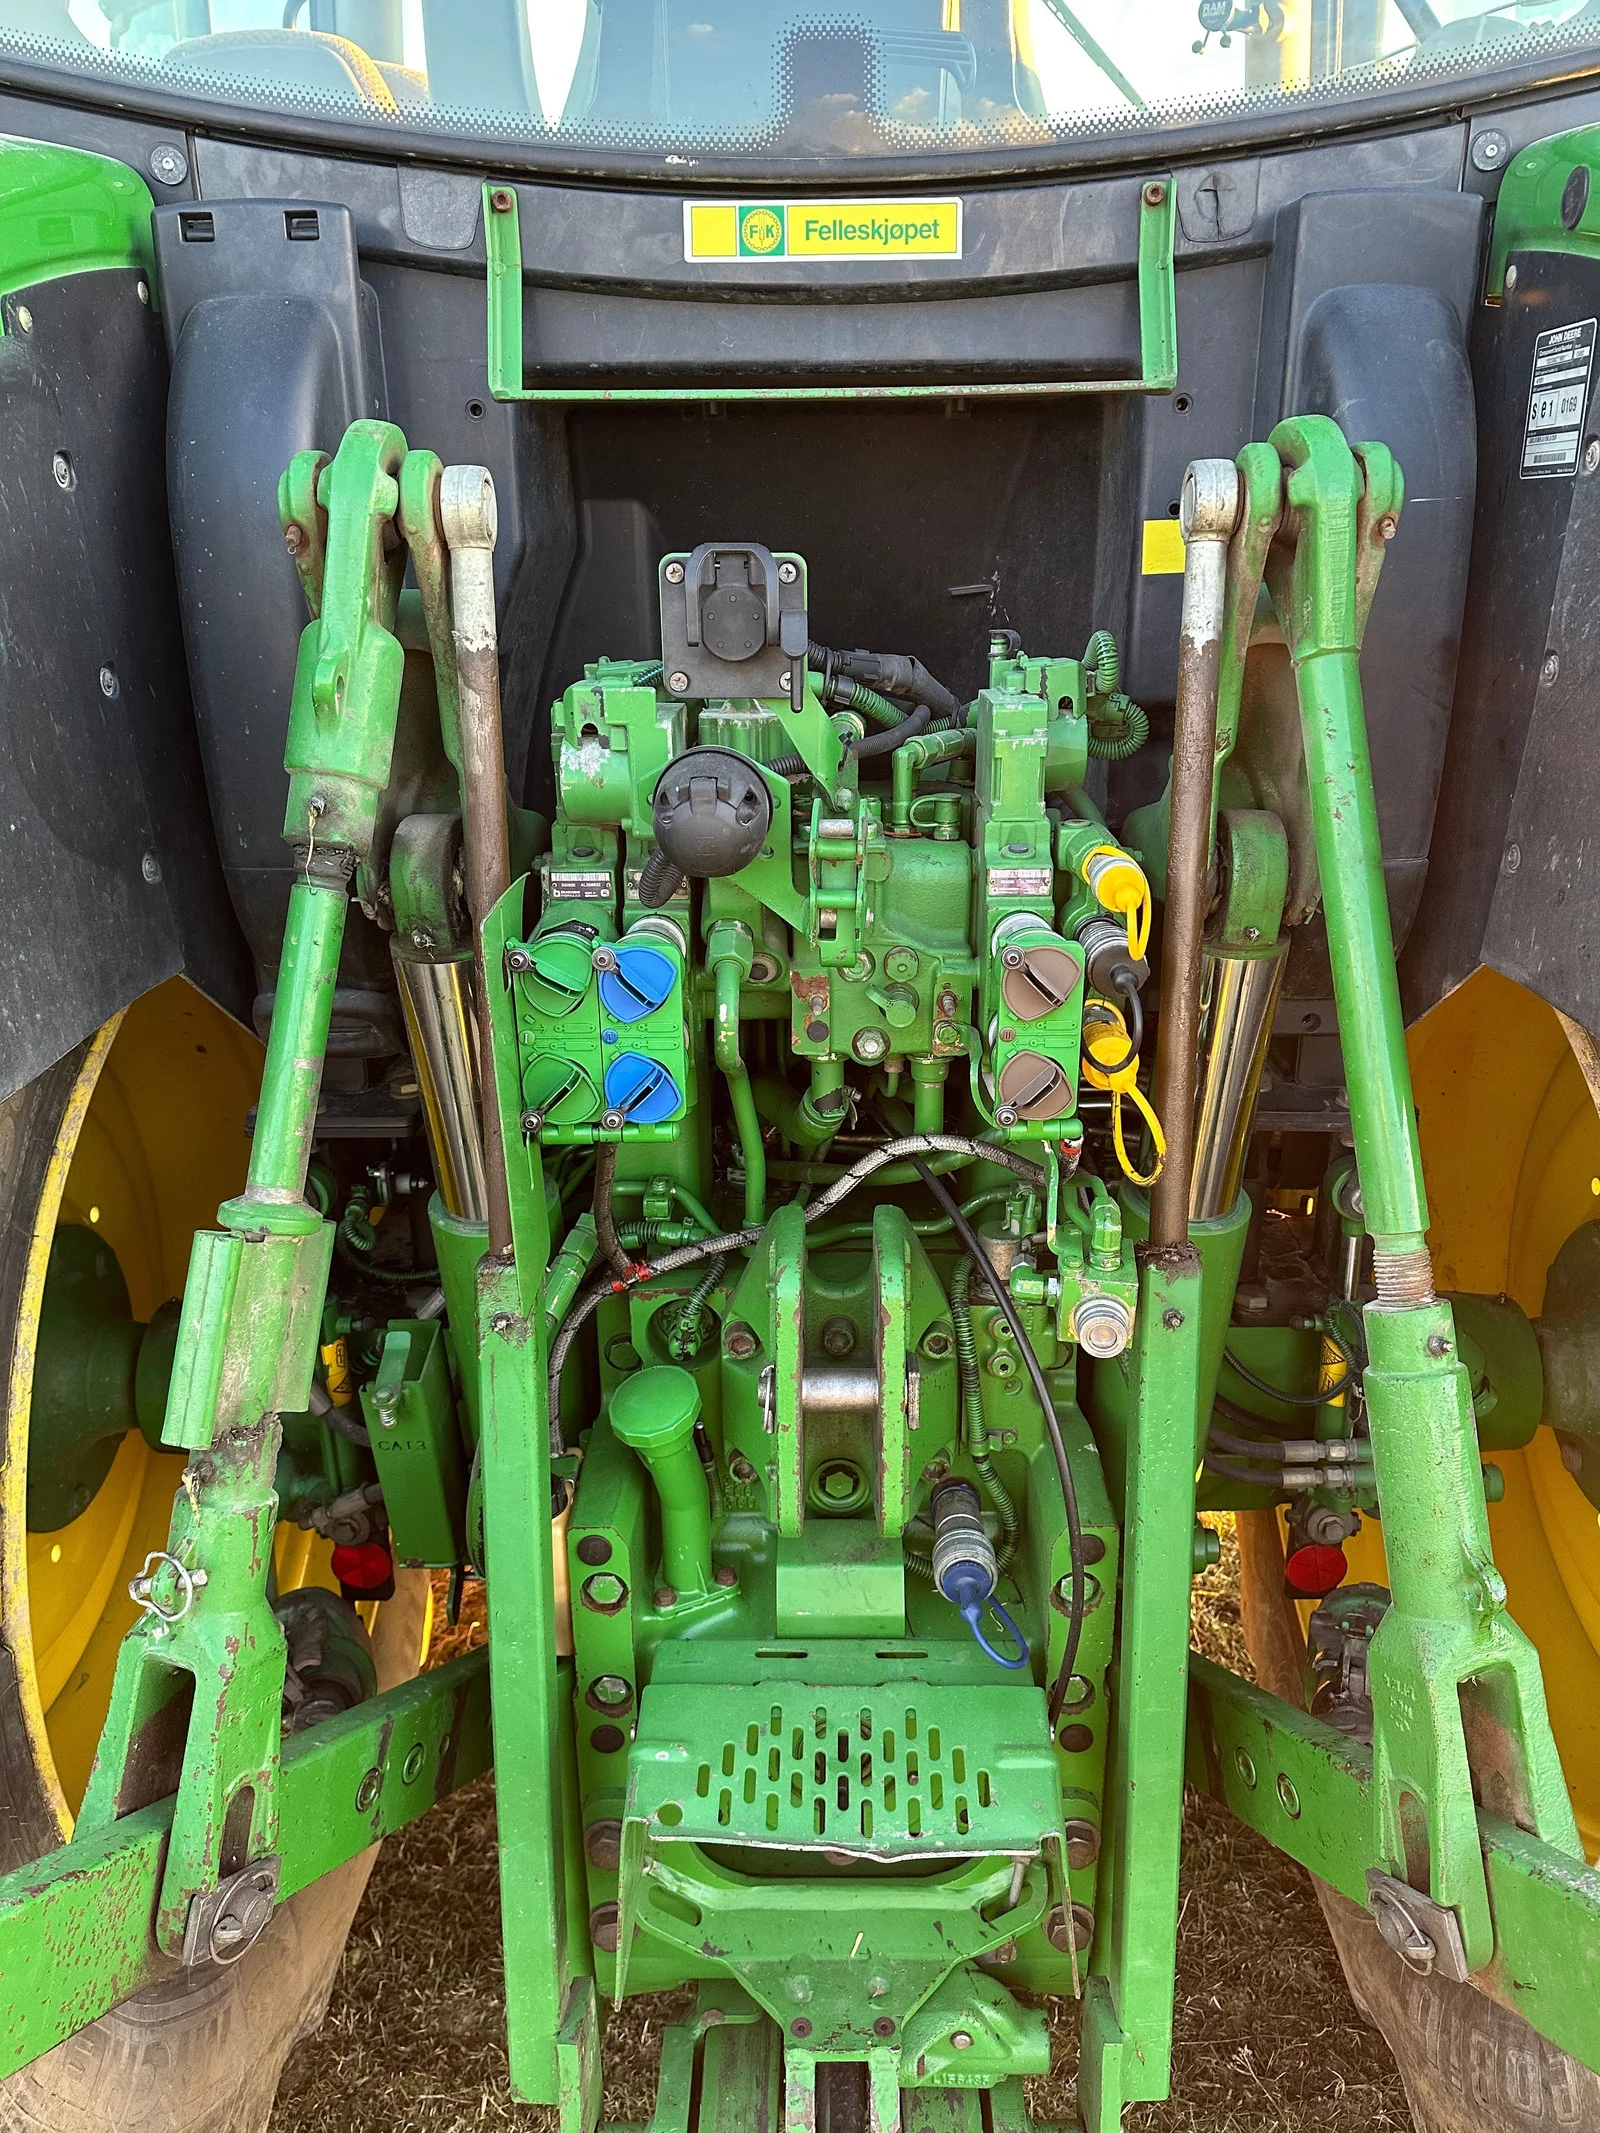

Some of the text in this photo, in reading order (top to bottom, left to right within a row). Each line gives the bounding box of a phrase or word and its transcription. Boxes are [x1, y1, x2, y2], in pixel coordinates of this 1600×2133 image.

[1203, 1, 1226, 14] RAM
[805, 219, 940, 245] Felleskjøpet
[1548, 327, 1582, 345] JOHN DEERE
[1561, 396, 1578, 413] 0169
